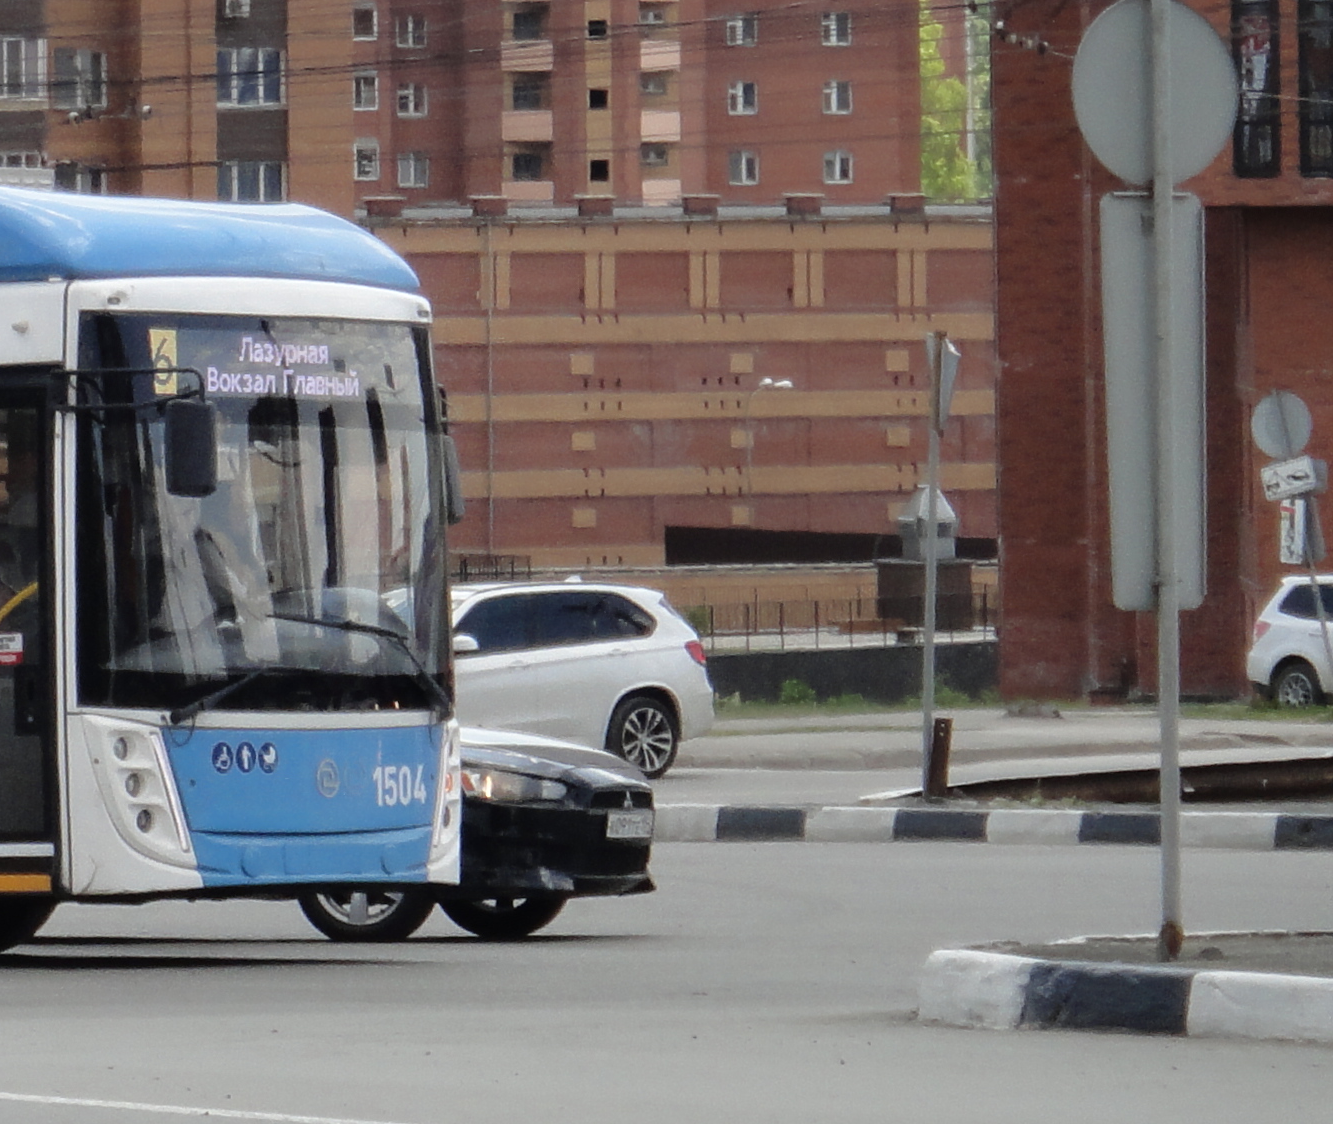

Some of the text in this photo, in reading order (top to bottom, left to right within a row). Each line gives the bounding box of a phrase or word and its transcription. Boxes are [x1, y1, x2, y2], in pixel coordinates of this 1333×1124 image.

[238, 337, 329, 366] Лазурная
[206, 367, 360, 396] Вокзал Главный
[373, 765, 427, 807] 1504
